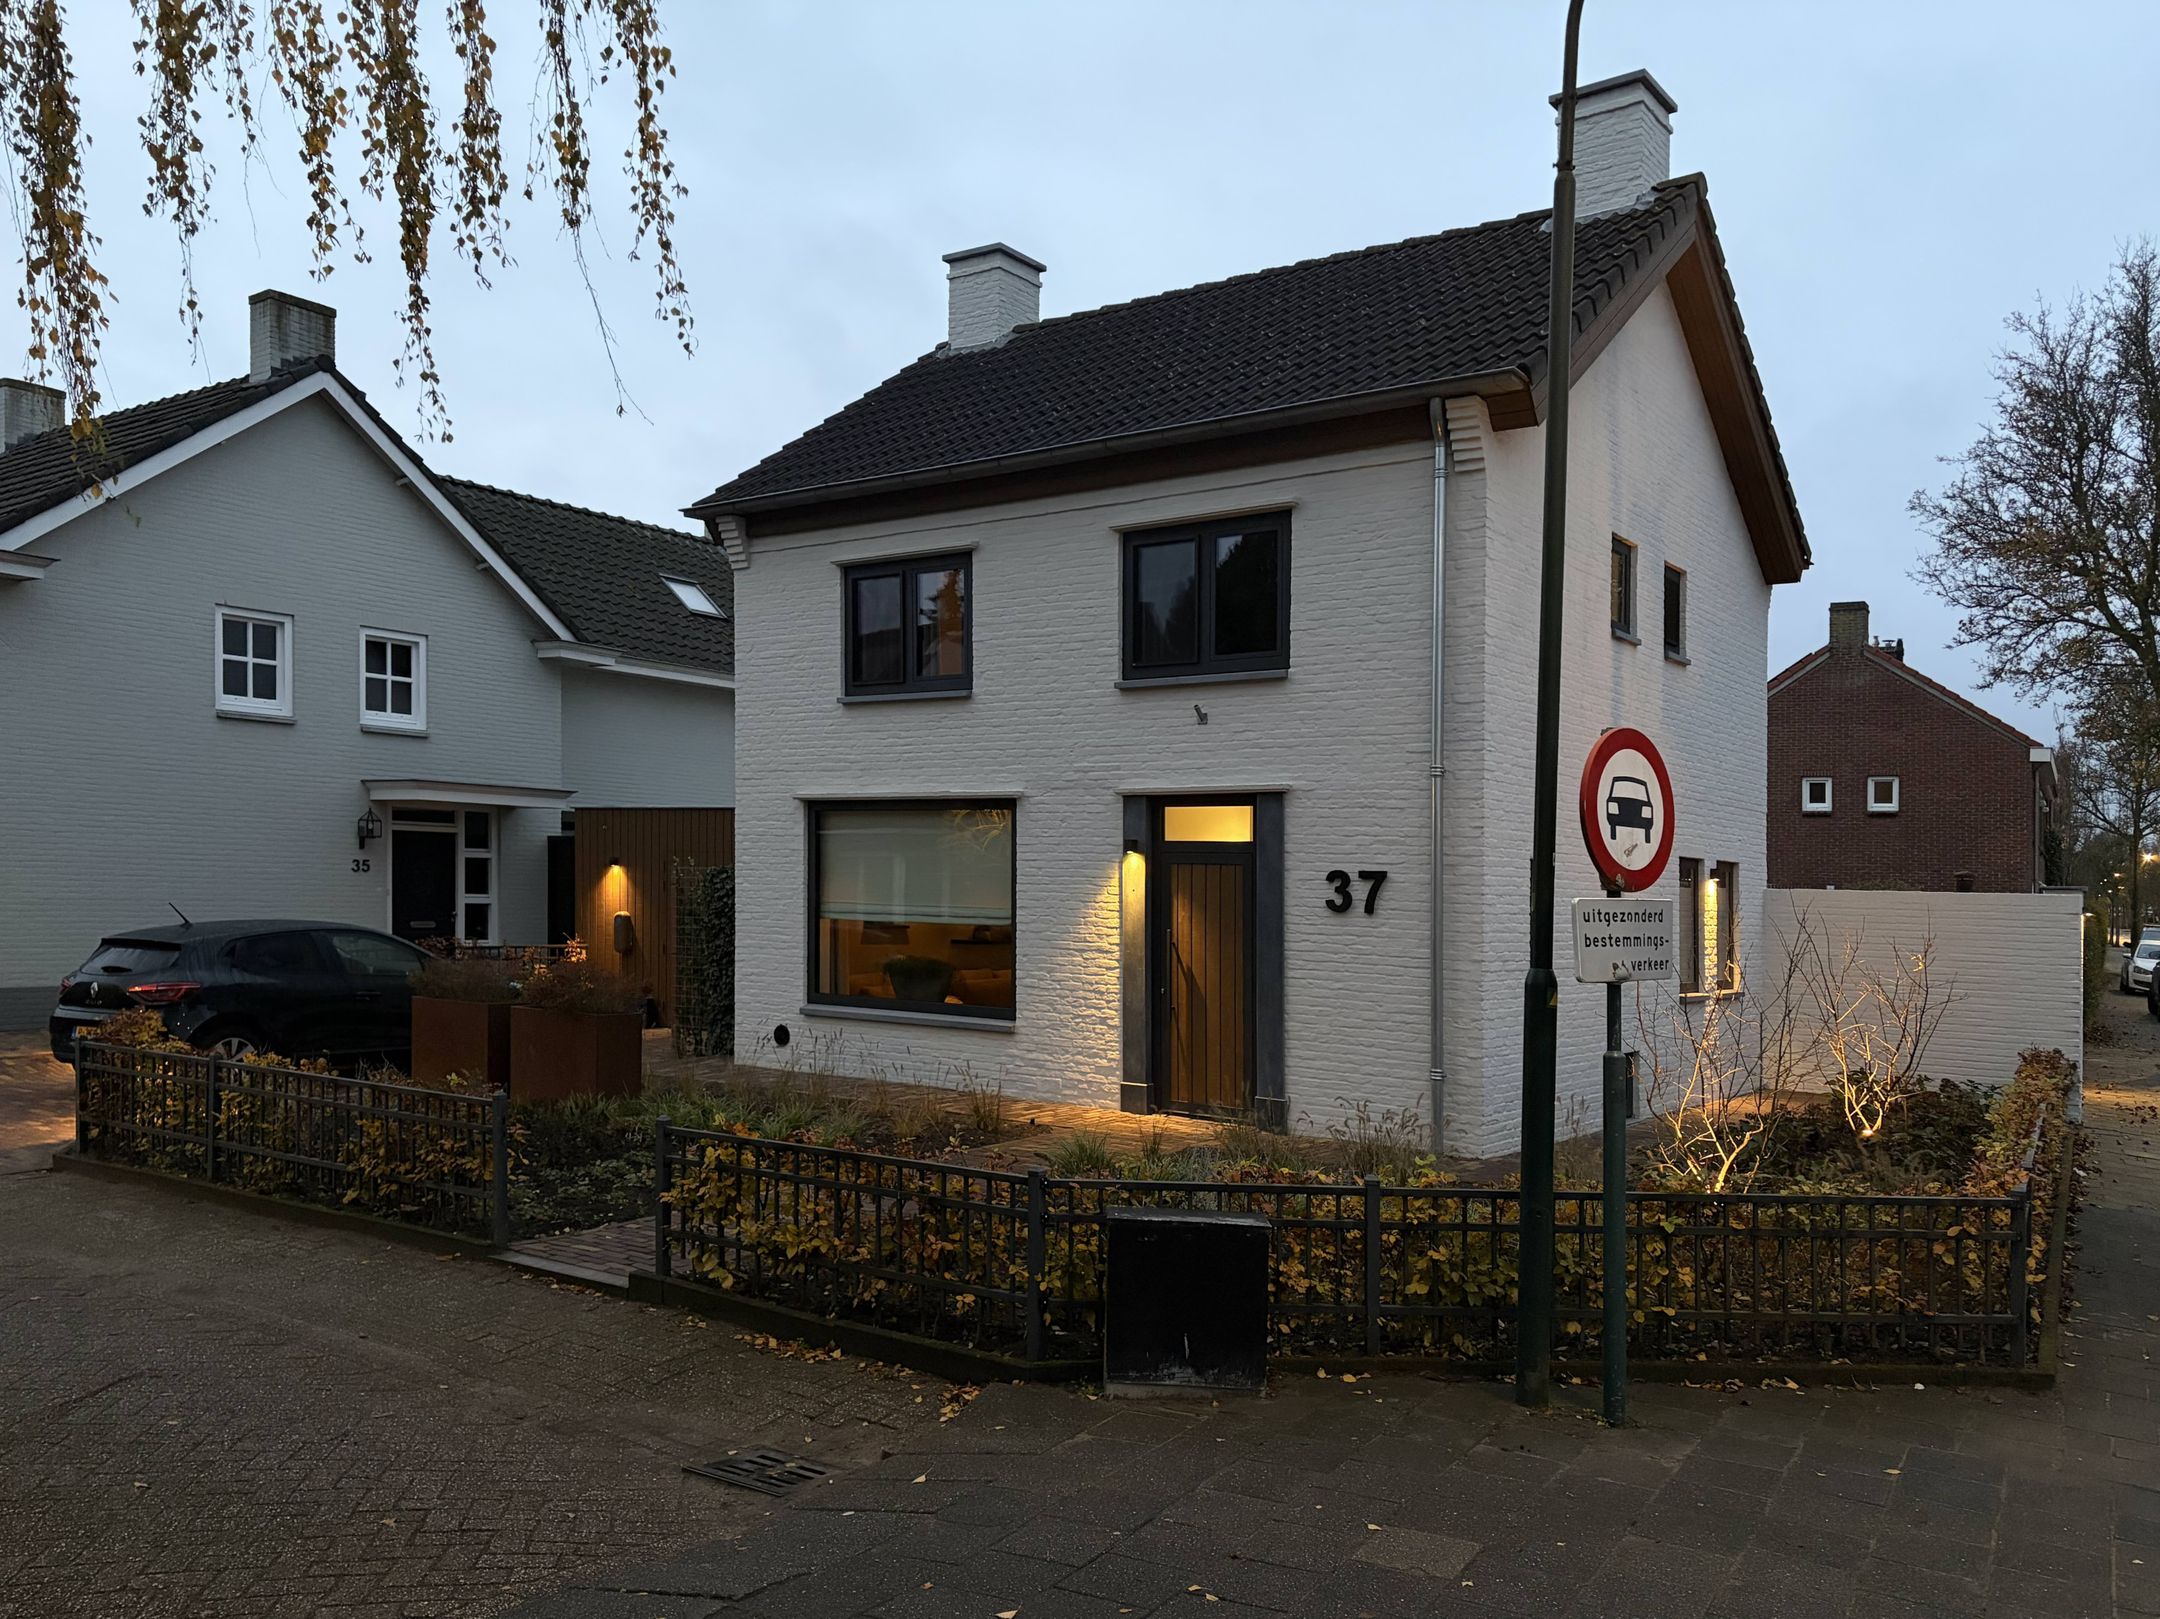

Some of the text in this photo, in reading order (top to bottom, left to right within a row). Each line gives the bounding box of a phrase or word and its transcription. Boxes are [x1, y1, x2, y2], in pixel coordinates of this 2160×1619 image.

[351, 859, 371, 873] 35
[1325, 869, 1388, 915] 37
[1582, 908, 1664, 927] uitgezonderd
[1584, 933, 1669, 950] bestemmings-
[1630, 956, 1669, 972] verkeer
